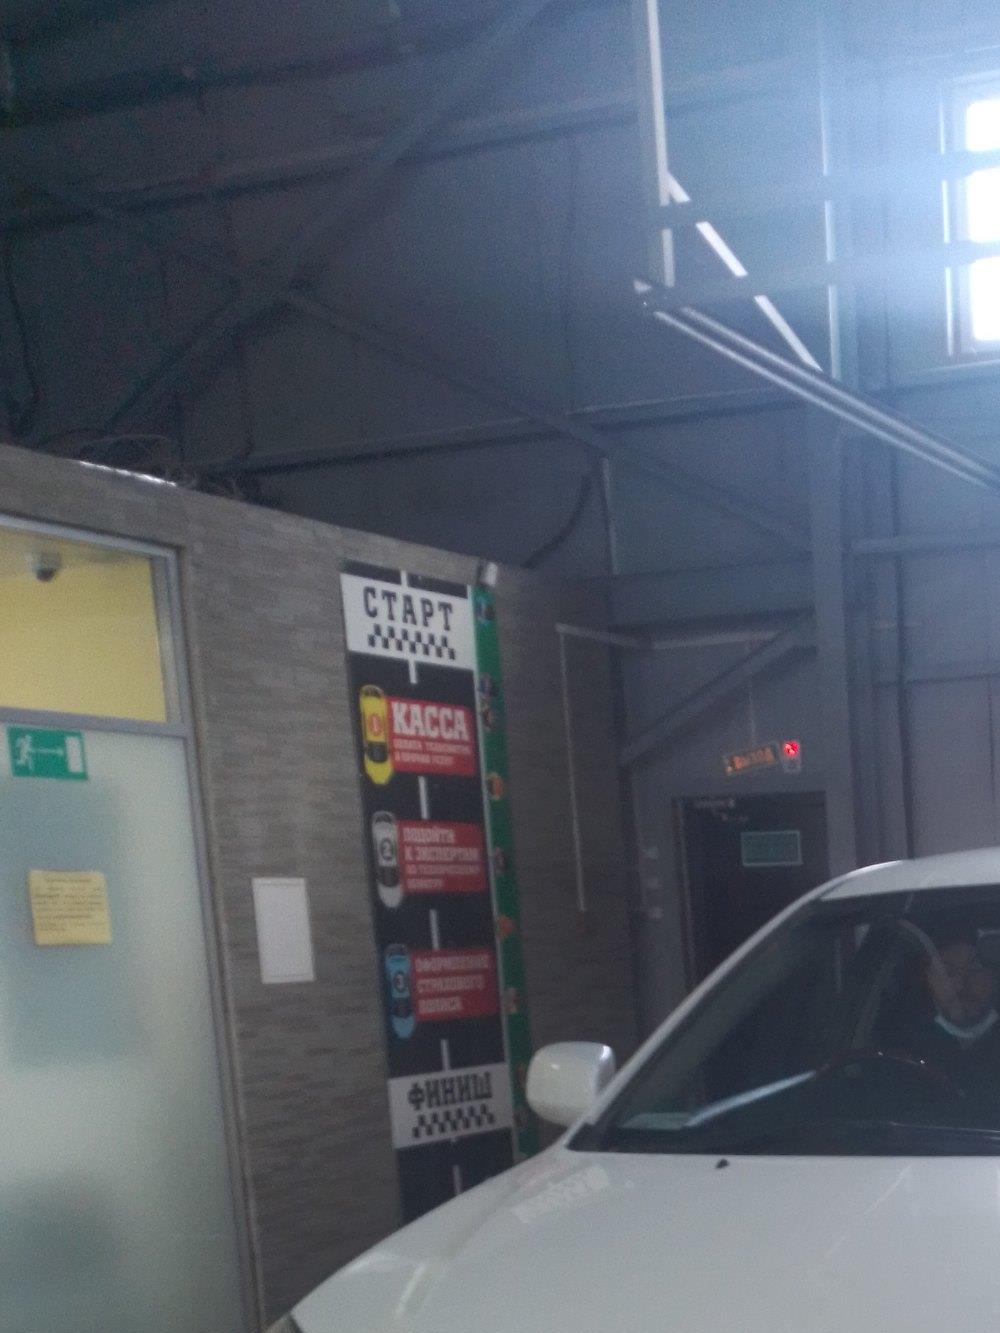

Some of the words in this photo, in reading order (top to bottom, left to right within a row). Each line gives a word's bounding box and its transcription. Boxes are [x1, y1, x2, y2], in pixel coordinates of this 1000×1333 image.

[363, 586, 453, 632] СТАРТ
[391, 701, 469, 741] КАССА
[408, 1071, 492, 1111] ФИНИШ
